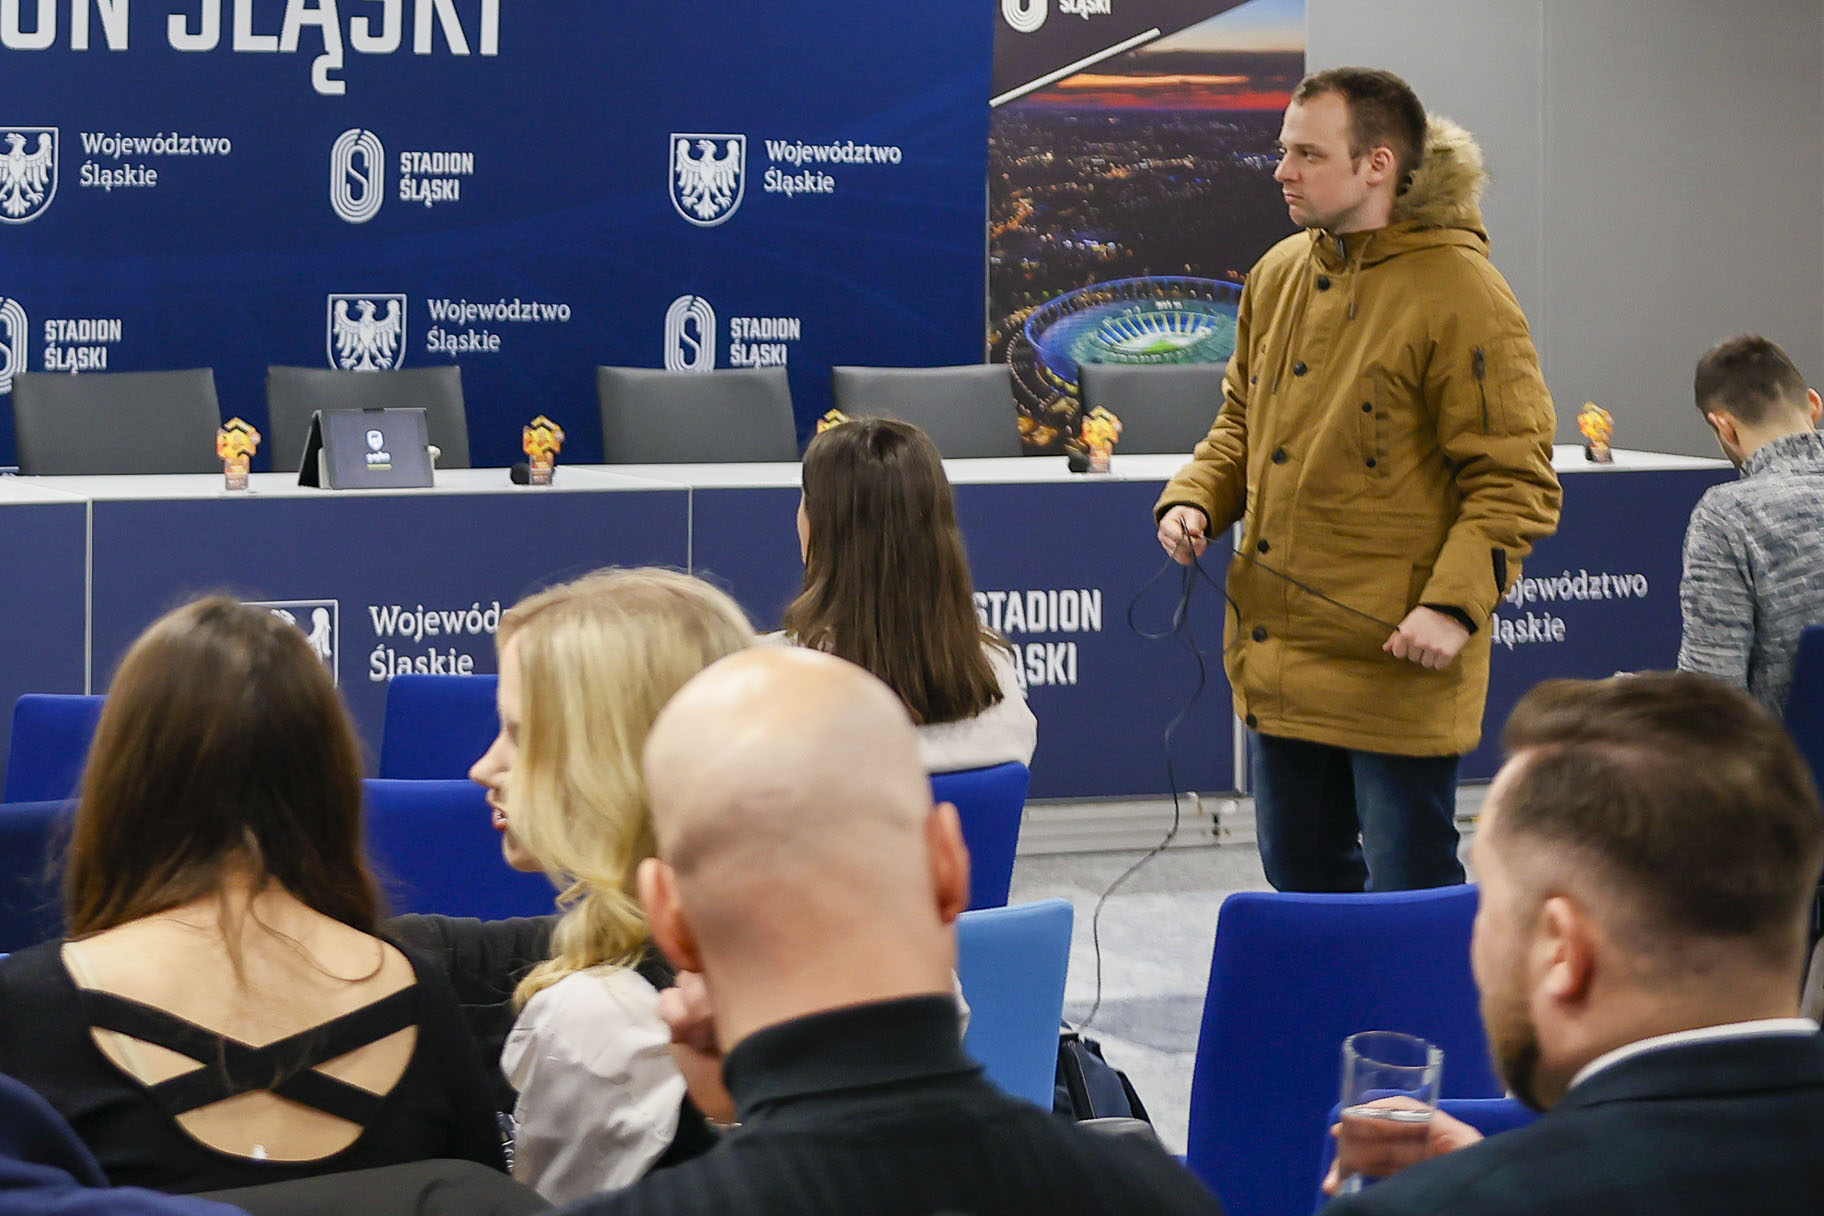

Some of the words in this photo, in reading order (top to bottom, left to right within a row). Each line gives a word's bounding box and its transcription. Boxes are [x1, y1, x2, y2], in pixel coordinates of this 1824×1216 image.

[79, 130, 232, 158] Województwo
[764, 138, 903, 167] Województwo
[79, 160, 158, 191] Śląskie
[400, 151, 474, 176] STADION
[399, 172, 460, 208] ŚLĄSKI
[763, 167, 836, 198] Śląskie
[426, 297, 572, 326] Województwo
[45, 319, 122, 343] STADION
[426, 325, 502, 356] Śląskie
[730, 317, 801, 341] STADION
[44, 341, 108, 375] ŚLĄSKI
[730, 339, 788, 369] ŚLĄSKI
[1505, 568, 1649, 609] jewództwo
[1491, 611, 1566, 652] ląskie
